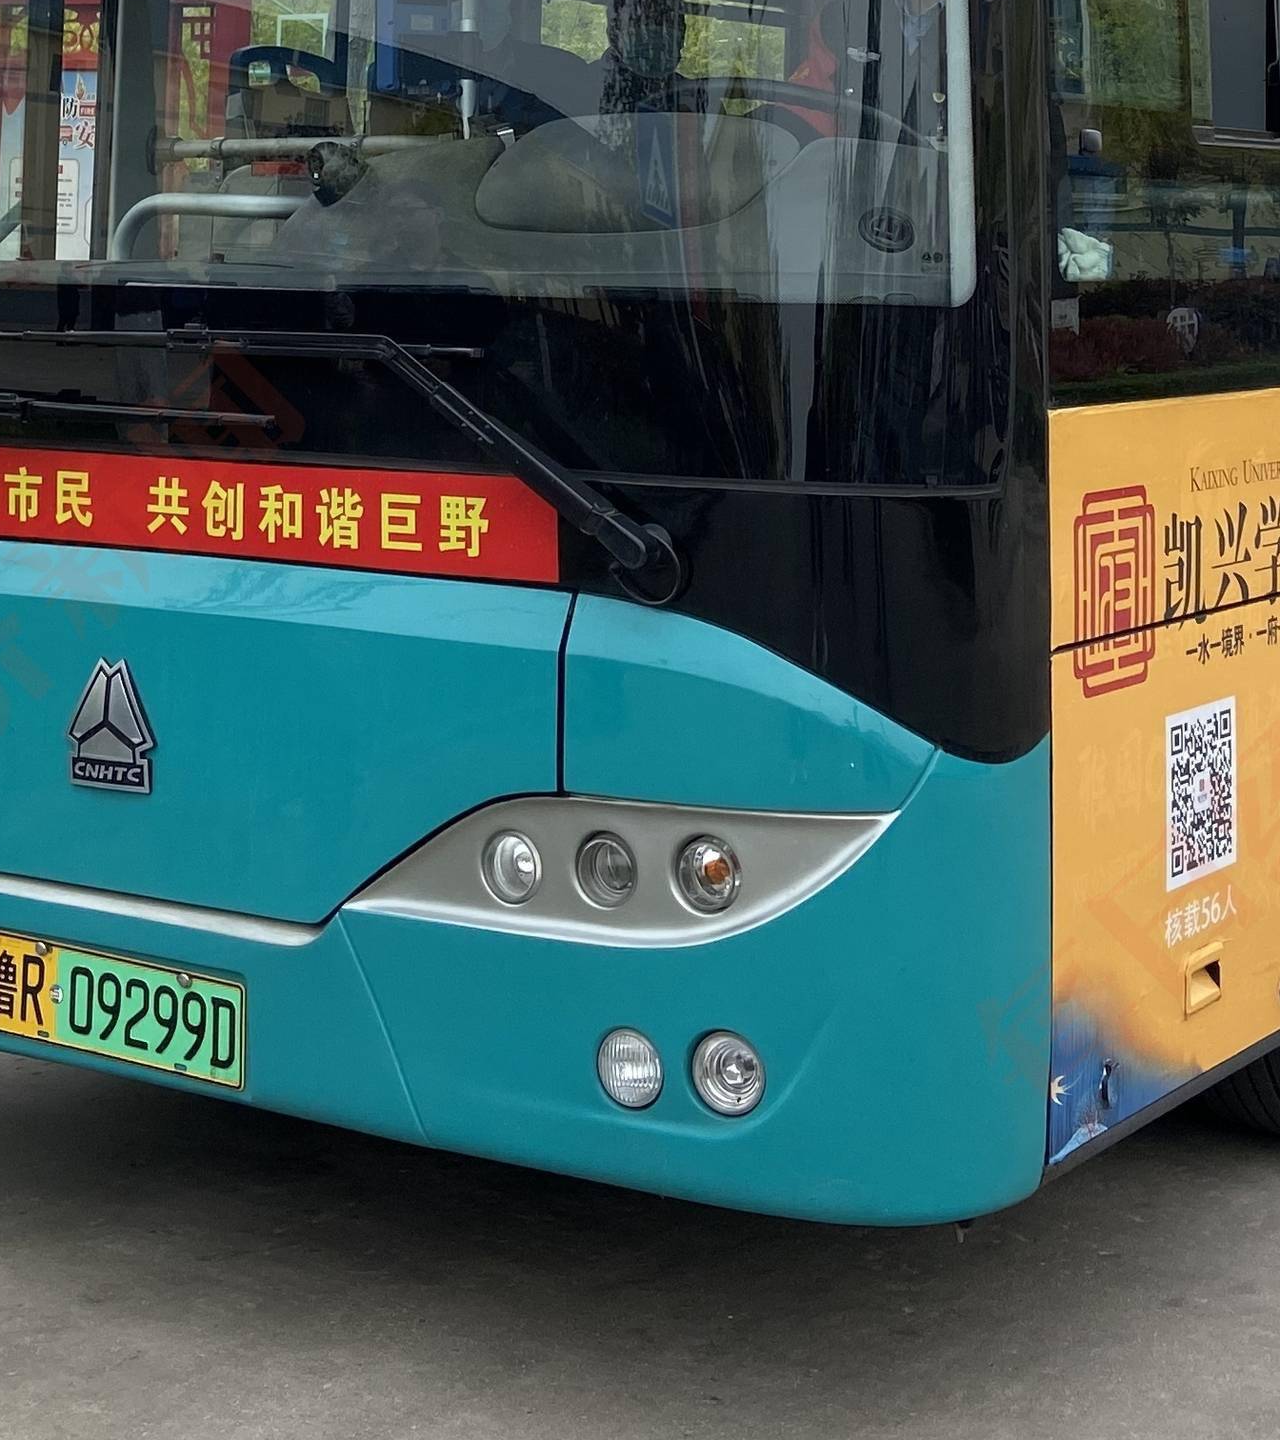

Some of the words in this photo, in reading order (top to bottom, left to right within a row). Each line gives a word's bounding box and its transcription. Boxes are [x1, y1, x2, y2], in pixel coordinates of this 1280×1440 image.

[147, 475, 490, 558] 共创和谐巨野
[74, 761, 141, 783] CNHTC
[1164, 883, 1237, 949] 核载56人
